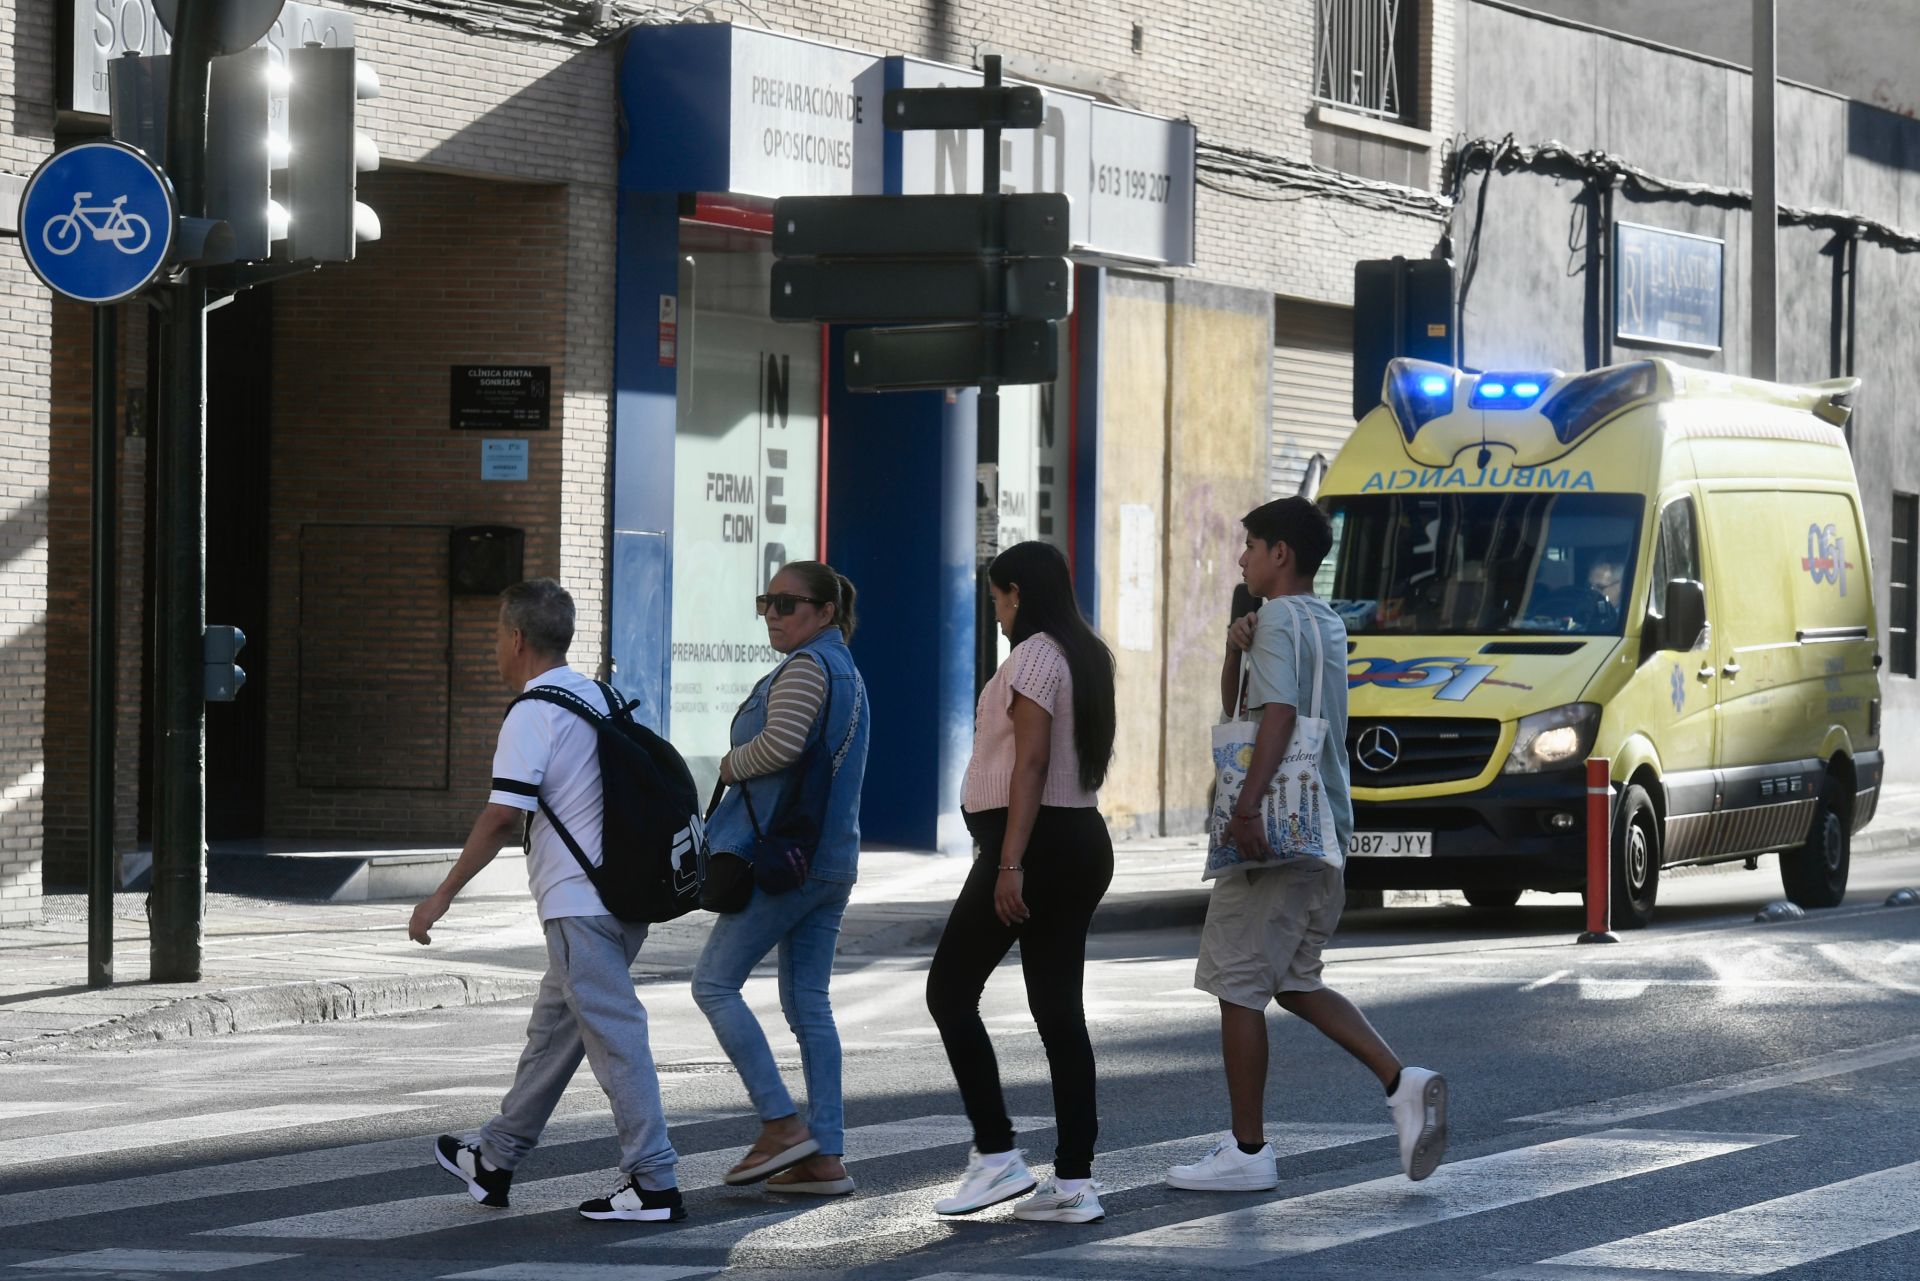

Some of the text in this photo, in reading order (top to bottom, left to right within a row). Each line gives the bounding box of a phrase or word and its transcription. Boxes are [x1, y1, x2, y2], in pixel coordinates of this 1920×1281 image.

[752, 75, 863, 124] PREPARACIÓN DE
[763, 127, 851, 169] OPOSICIONES
[1099, 164, 1171, 204] 613 199 207
[468, 368, 533, 377] CLÍNICA DENTAL
[480, 378, 521, 387] SONRISAS
[706, 472, 754, 504] FORMA
[722, 513, 753, 543] CION
[672, 640, 733, 663] PREPARACIÓN
[735, 643, 746, 662] DE
[1349, 835, 1427, 853] 087 JYY
